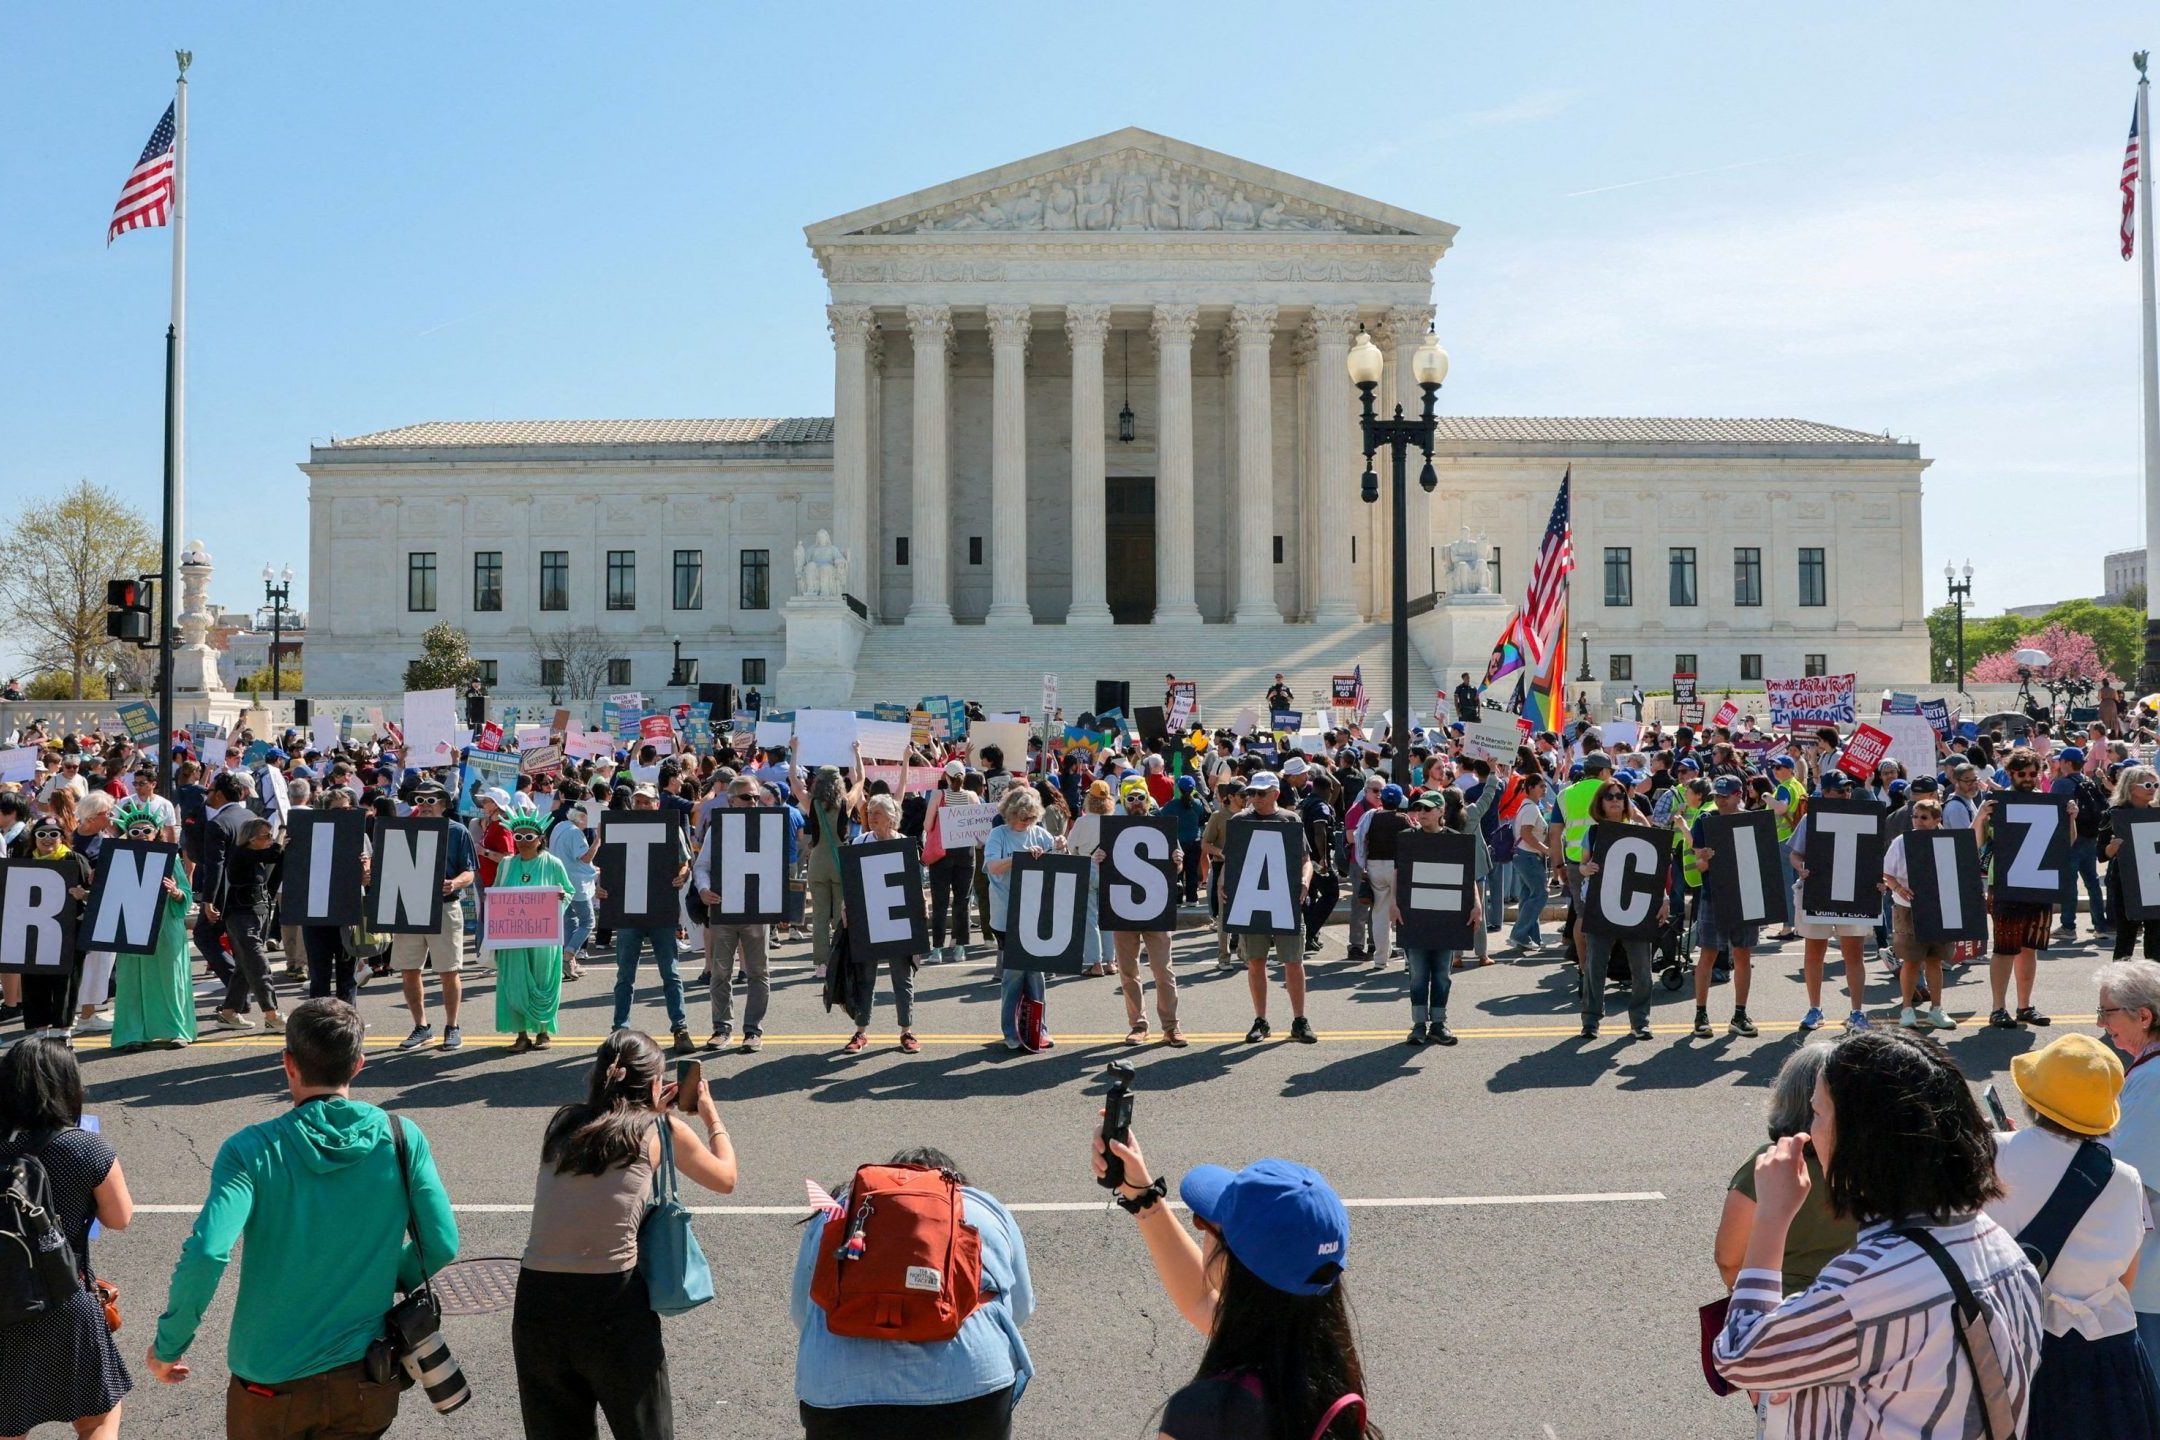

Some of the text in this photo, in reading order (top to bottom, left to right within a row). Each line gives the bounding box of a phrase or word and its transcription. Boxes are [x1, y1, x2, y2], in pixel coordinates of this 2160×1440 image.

[1481, 742, 1514, 751] Constitution
[1486, 736, 1506, 745] literally
[1854, 733, 1885, 756] BIRTH
[1848, 743, 1880, 765] RIGHT
[491, 893, 546, 905] CITIZENSHIP
[508, 908, 515, 916] IS
[488, 918, 551, 935] BIRTHRIGHT
[1318, 1241, 1339, 1256] ACLU
